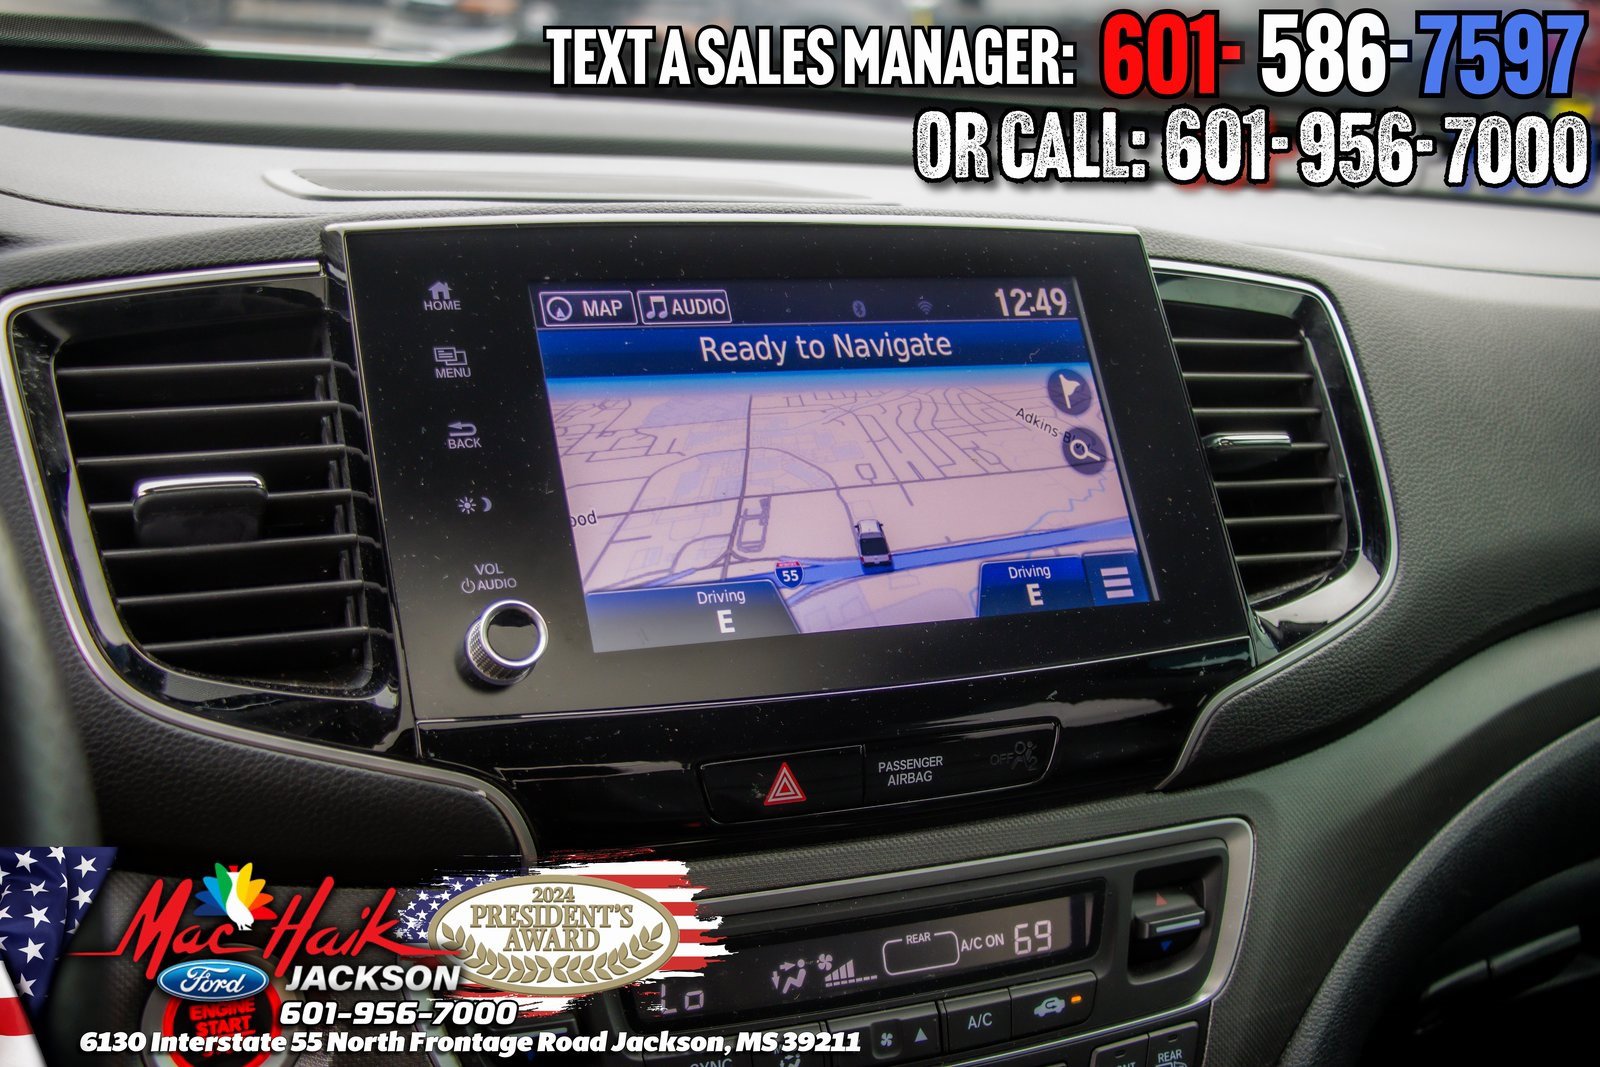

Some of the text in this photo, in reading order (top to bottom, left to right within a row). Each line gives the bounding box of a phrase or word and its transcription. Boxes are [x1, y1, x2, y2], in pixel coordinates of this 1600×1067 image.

[424, 300, 462, 311] HOME
[582, 300, 623, 317] MAP
[671, 299, 727, 316] AUDIO
[995, 288, 1068, 317] 12:49
[700, 331, 953, 366] Ready to Navigate
[435, 367, 471, 378] MENU
[1016, 408, 1059, 437] Adkins
[447, 438, 482, 449] BACK
[474, 563, 504, 575] VOL
[782, 570, 799, 582] 55
[1008, 565, 1051, 579] Driving
[477, 577, 518, 591] AUDIO
[697, 589, 746, 605] Driving
[1026, 583, 1044, 606] E
[717, 609, 736, 634] E
[878, 755, 943, 773] PASSENGER
[887, 770, 933, 786] AIRBAG
[906, 932, 931, 944] REAR
[961, 933, 1005, 952] A/C ON
[1014, 919, 1052, 955] 69
[189, 1000, 256, 1021] ENGINE
[196, 1015, 253, 1037] START
[968, 1012, 993, 1030] A/C
[1158, 1049, 1182, 1063] REAR
